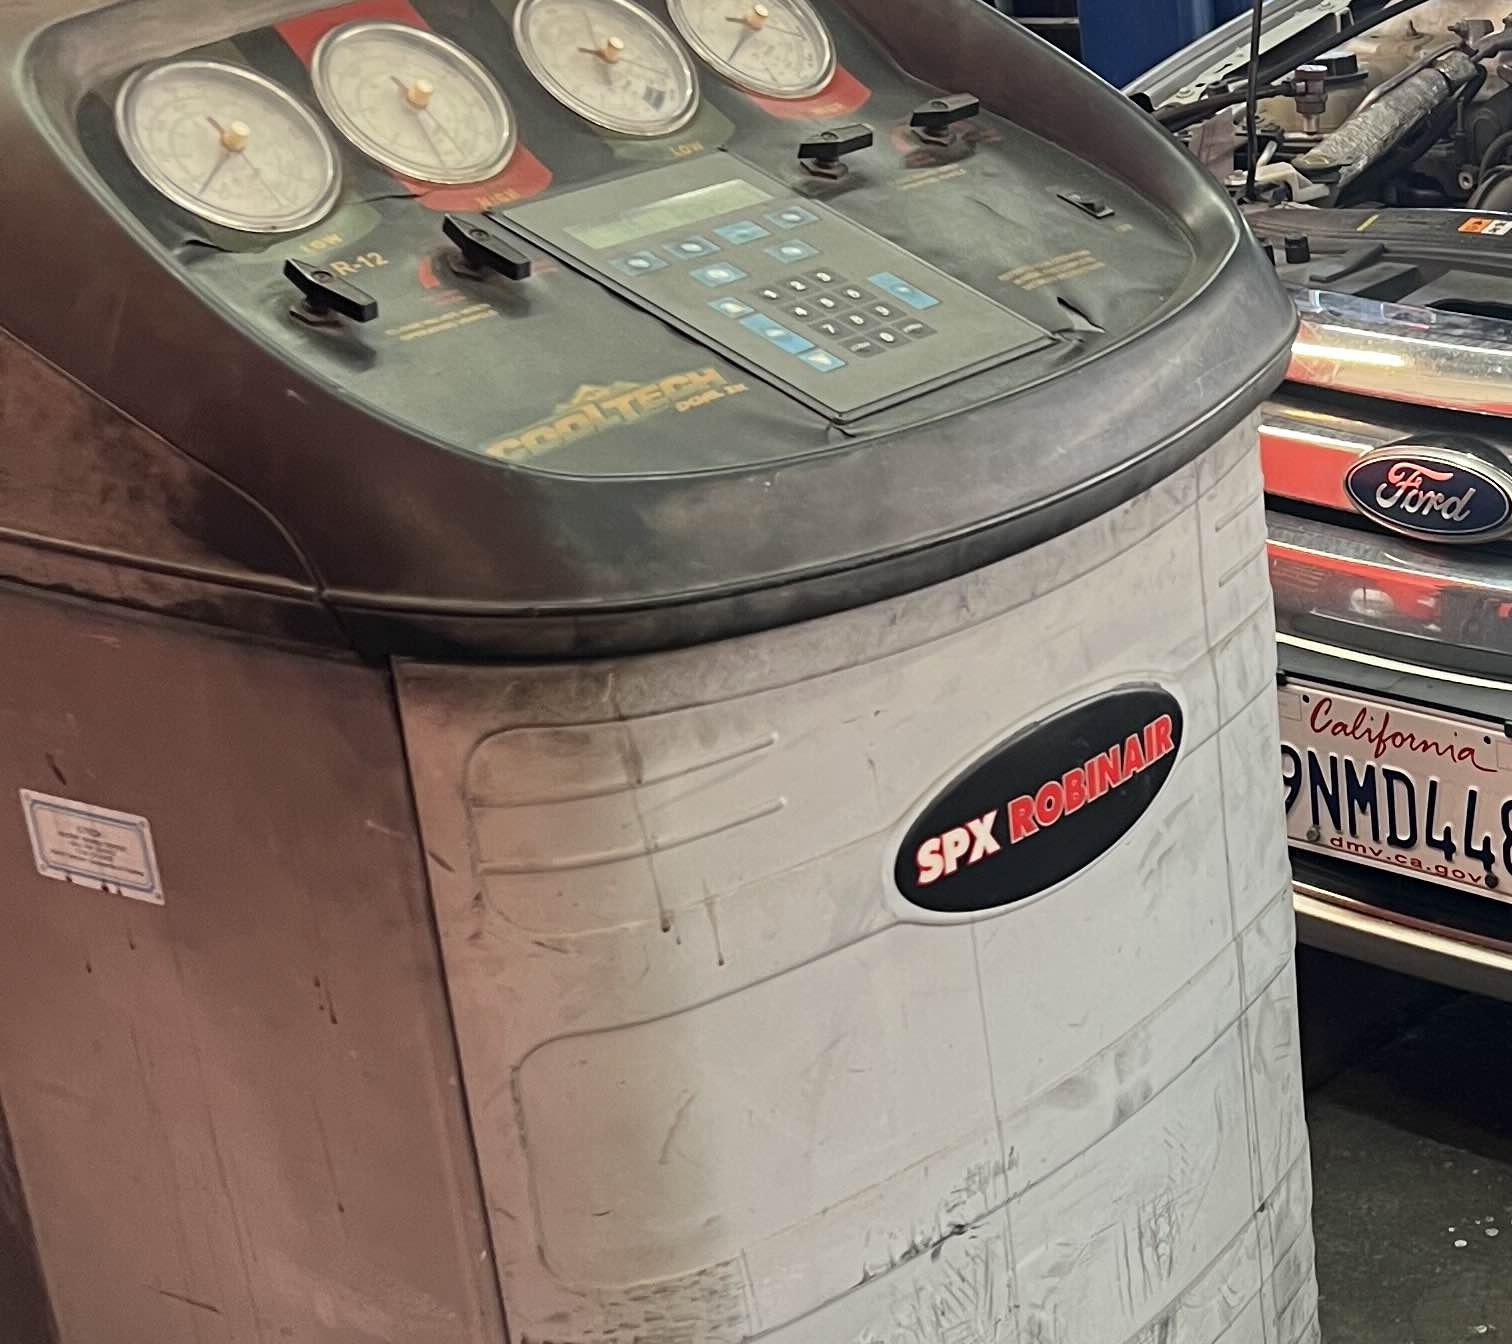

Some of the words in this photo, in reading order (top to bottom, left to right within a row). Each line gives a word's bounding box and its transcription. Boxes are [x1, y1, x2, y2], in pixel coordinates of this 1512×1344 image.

[331, 252, 389, 277] R-12
[1375, 462, 1477, 522] Ford
[1310, 697, 1498, 774] California
[915, 808, 1001, 886] SPX
[1007, 713, 1175, 845] ROBINAIR
[1329, 835, 1484, 885] dmv.ca.gov
